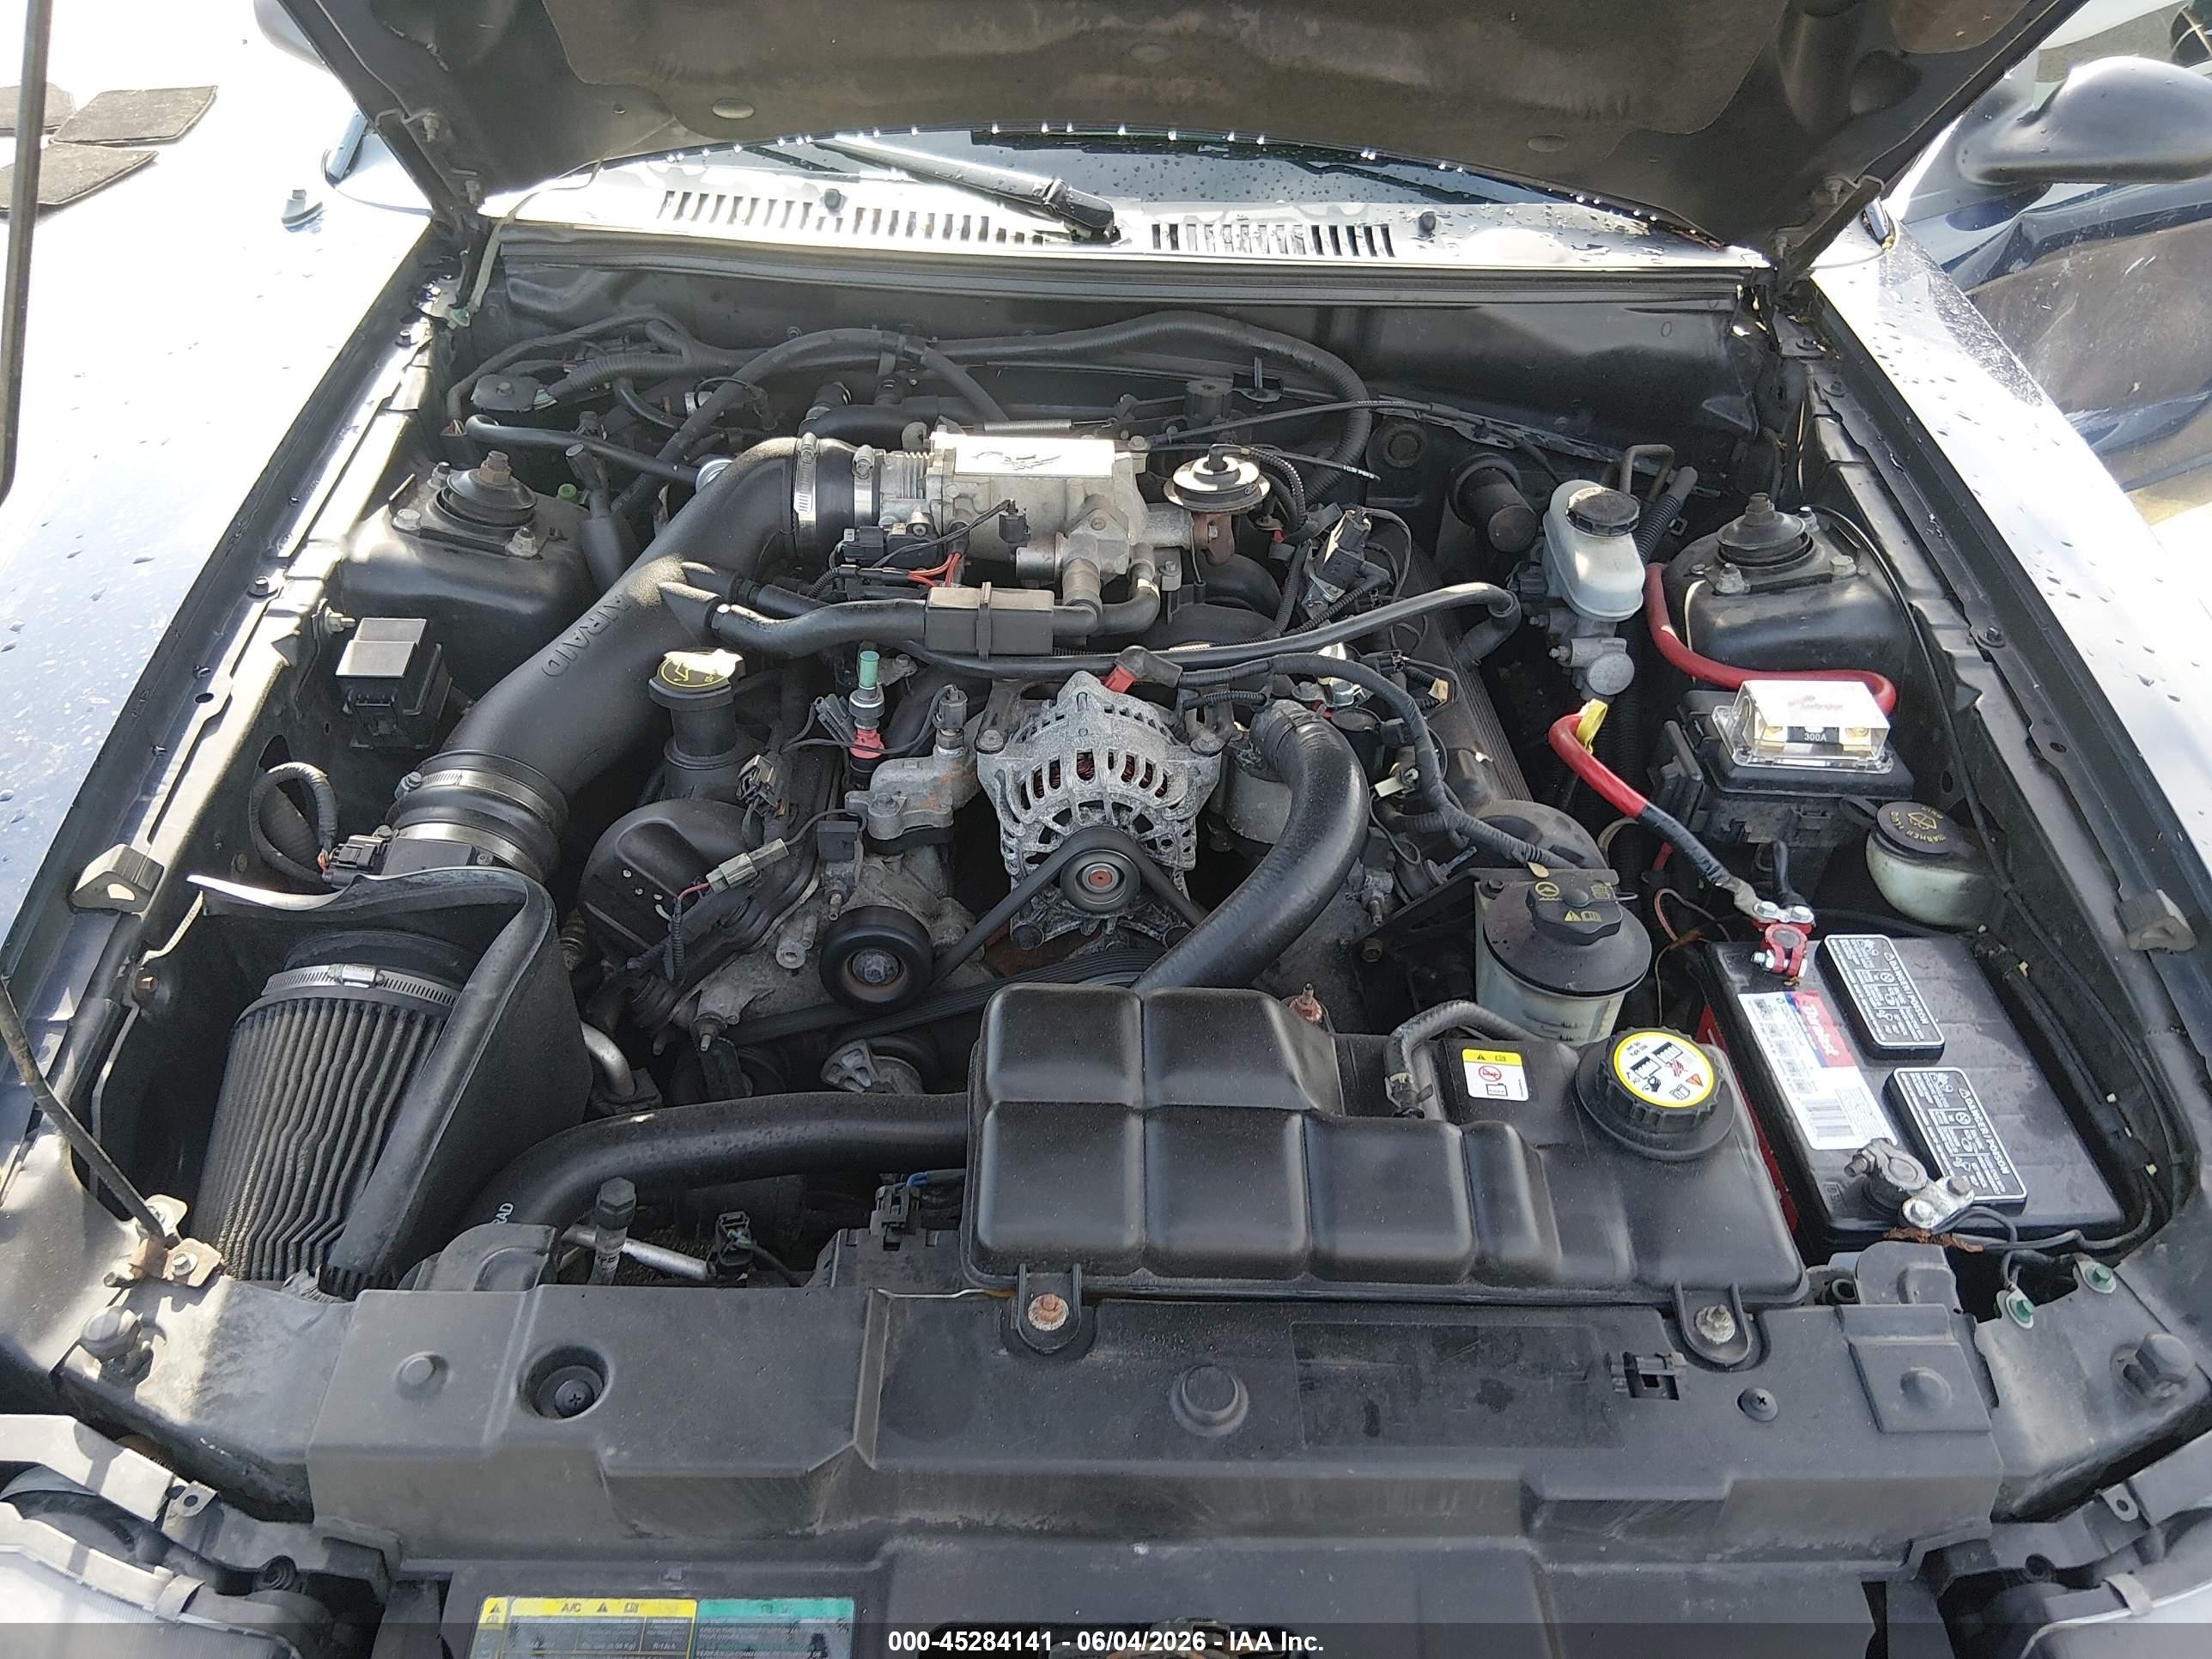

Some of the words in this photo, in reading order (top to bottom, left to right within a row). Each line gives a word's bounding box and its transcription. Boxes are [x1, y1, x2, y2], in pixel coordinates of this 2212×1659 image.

[1803, 732, 1827, 742] 300A
[1985, 1137, 2010, 1176] POISON
[562, 1602, 581, 1613] A/C
